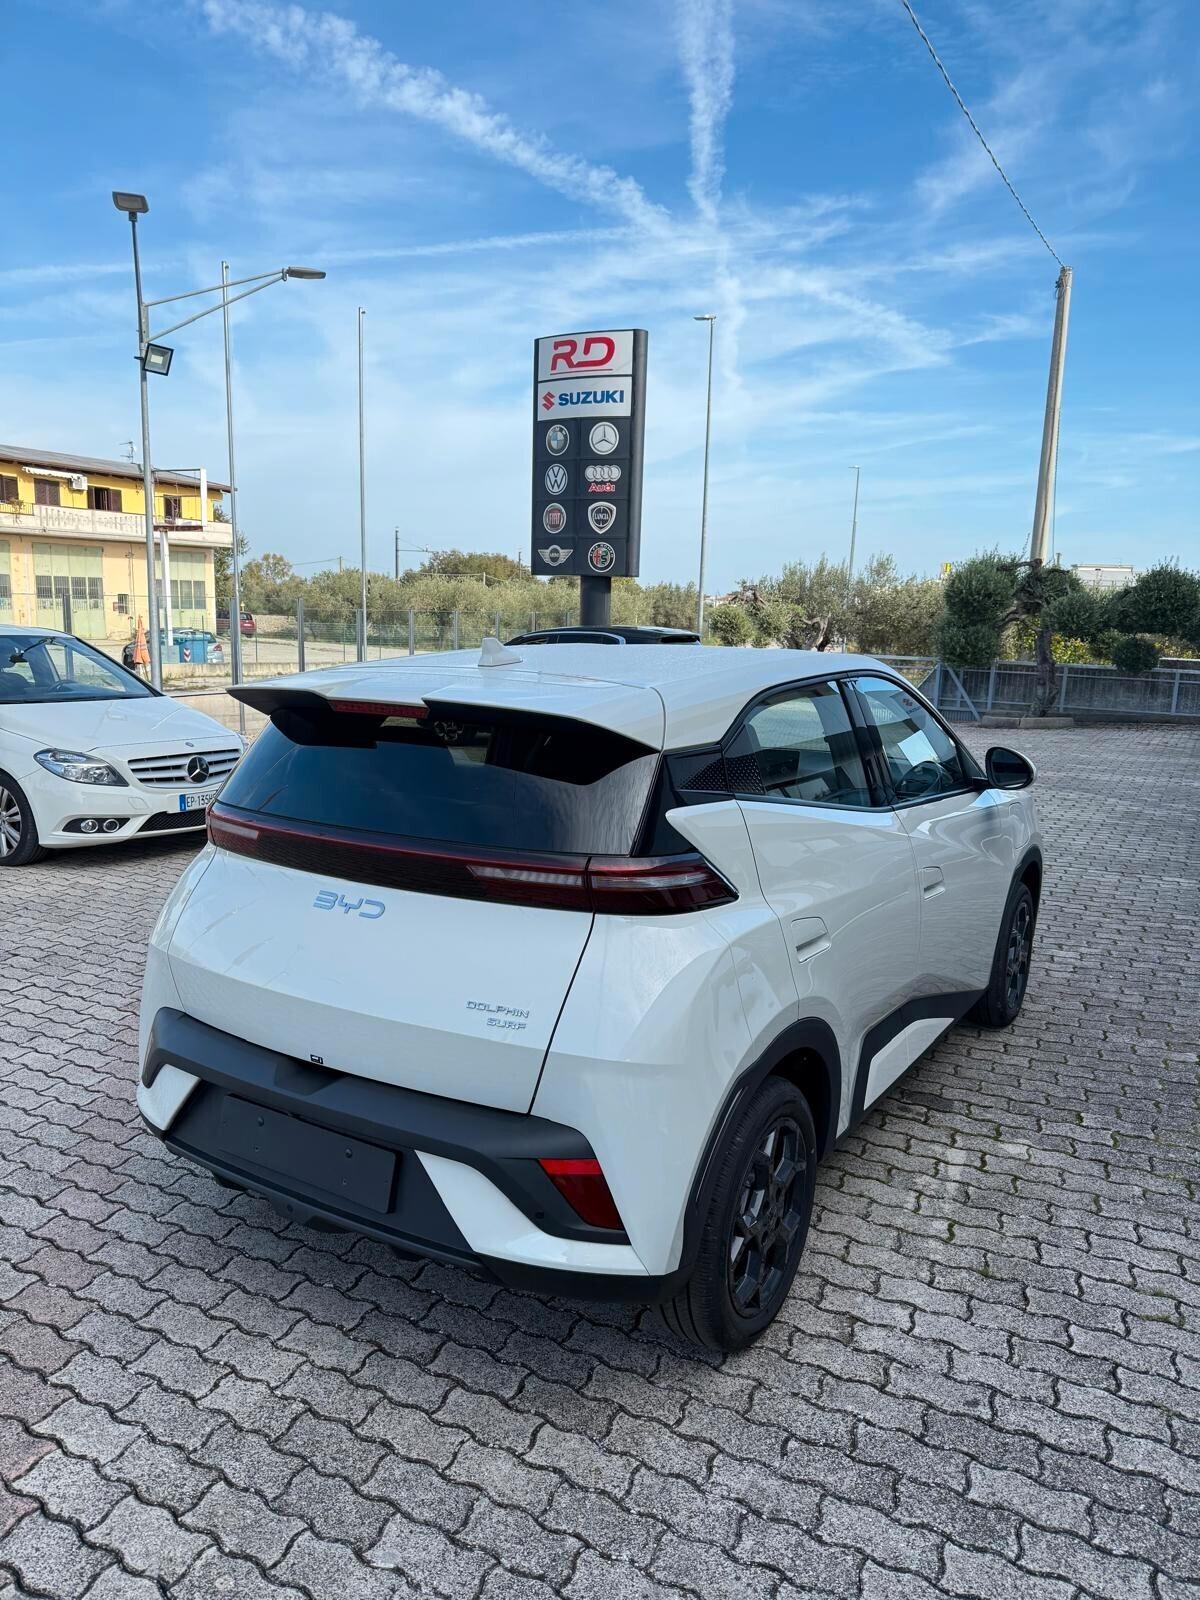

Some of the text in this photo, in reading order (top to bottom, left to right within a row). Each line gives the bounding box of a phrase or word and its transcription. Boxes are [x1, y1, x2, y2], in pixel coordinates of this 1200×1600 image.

[550, 336, 615, 372] RD
[558, 389, 625, 407] SUZUKI
[588, 482, 616, 493] Audi
[313, 889, 386, 920] BYD
[466, 1000, 530, 1019] DOLPHIN
[486, 1018, 527, 1030] SURF
